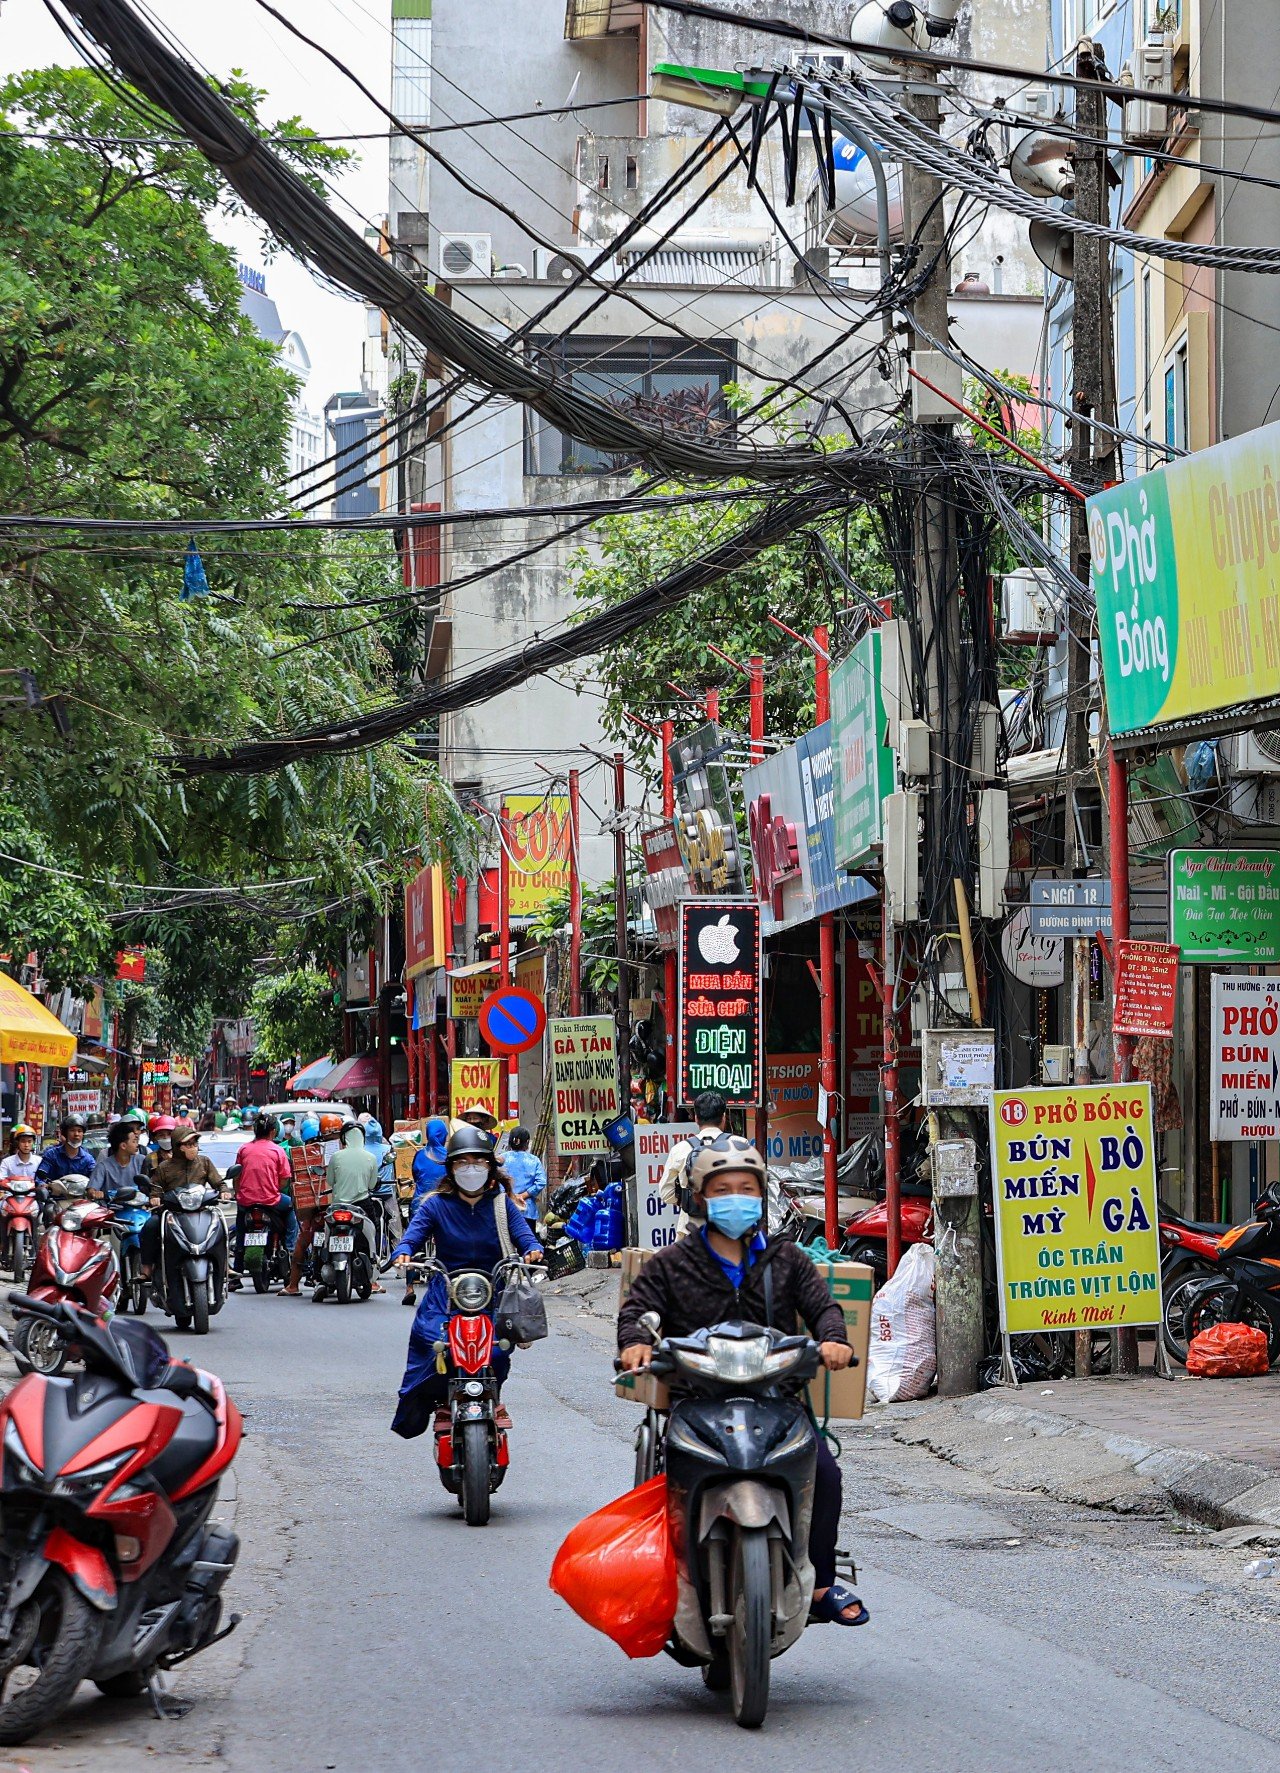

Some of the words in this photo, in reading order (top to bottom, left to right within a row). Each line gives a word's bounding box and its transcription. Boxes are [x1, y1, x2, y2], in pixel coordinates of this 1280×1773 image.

[1107, 490, 1157, 593] Phở
[1115, 590, 1169, 682] Bống
[1052, 885, 1075, 905] NGÕ
[1084, 888, 1097, 905] 18
[1177, 884, 1201, 901] Nail
[1211, 885, 1227, 901] Mi
[1238, 885, 1255, 903] Gội
[1258, 881, 1280, 901] Đầu
[519, 900, 529, 909] 34
[1039, 915, 1070, 927] ĐƯỜNG
[1072, 914, 1094, 927] ĐÌNH
[1095, 914, 1112, 927] THÔ
[1017, 952, 1043, 962] Store
[1130, 944, 1147, 952] CHO
[1149, 944, 1170, 954] THUÊ
[1254, 947, 1275, 956] 30M
[689, 974, 720, 991] MUA
[723, 970, 752, 990] BÁN
[1222, 982, 1237, 993] THU
[1238, 981, 1261, 993] HƯỜNG
[1267, 982, 1274, 993] 20
[687, 995, 716, 1017] SỬA
[1222, 993, 1278, 1037] PHỞ
[554, 1024, 572, 1034] Hoàn
[574, 1024, 597, 1035] Hương
[696, 1024, 746, 1059] ĐIỆN
[554, 1035, 576, 1055] GÀ
[1221, 1042, 1269, 1063] BÚN
[575, 1053, 593, 1080] CUỐN
[595, 1055, 614, 1080] NÓNG
[689, 1063, 752, 1093] THOẠI
[1221, 1067, 1270, 1091] MIẾN
[557, 1085, 586, 1114] BÚN
[1003, 1103, 1023, 1121] 18
[1034, 1096, 1077, 1124] PHỞ
[1083, 1093, 1144, 1121] BỐNG
[1219, 1093, 1239, 1119] PHỞ
[1246, 1096, 1266, 1119] BÚN
[1240, 1125, 1275, 1138] RƯỢU
[560, 1139, 586, 1151] TRỨNG
[588, 1140, 600, 1151] VỊT
[639, 1131, 668, 1158] ĐIỆN
[1008, 1134, 1071, 1162] BÚN
[1099, 1125, 1144, 1171] BÒ
[1003, 1166, 1080, 1200] MIẾN
[646, 1190, 667, 1216] ỐP
[1022, 1206, 1066, 1235] MỲ
[1102, 1187, 1150, 1233] GÀ
[651, 1223, 676, 1247] GIÁ
[1070, 1241, 1123, 1265] TRẦN
[1008, 1277, 1075, 1300] TRỨNG
[1081, 1275, 1111, 1298] VỊT
[1117, 1270, 1156, 1294] LỘN
[1041, 1308, 1077, 1326] Kính
[1081, 1305, 1115, 1323] Mời
